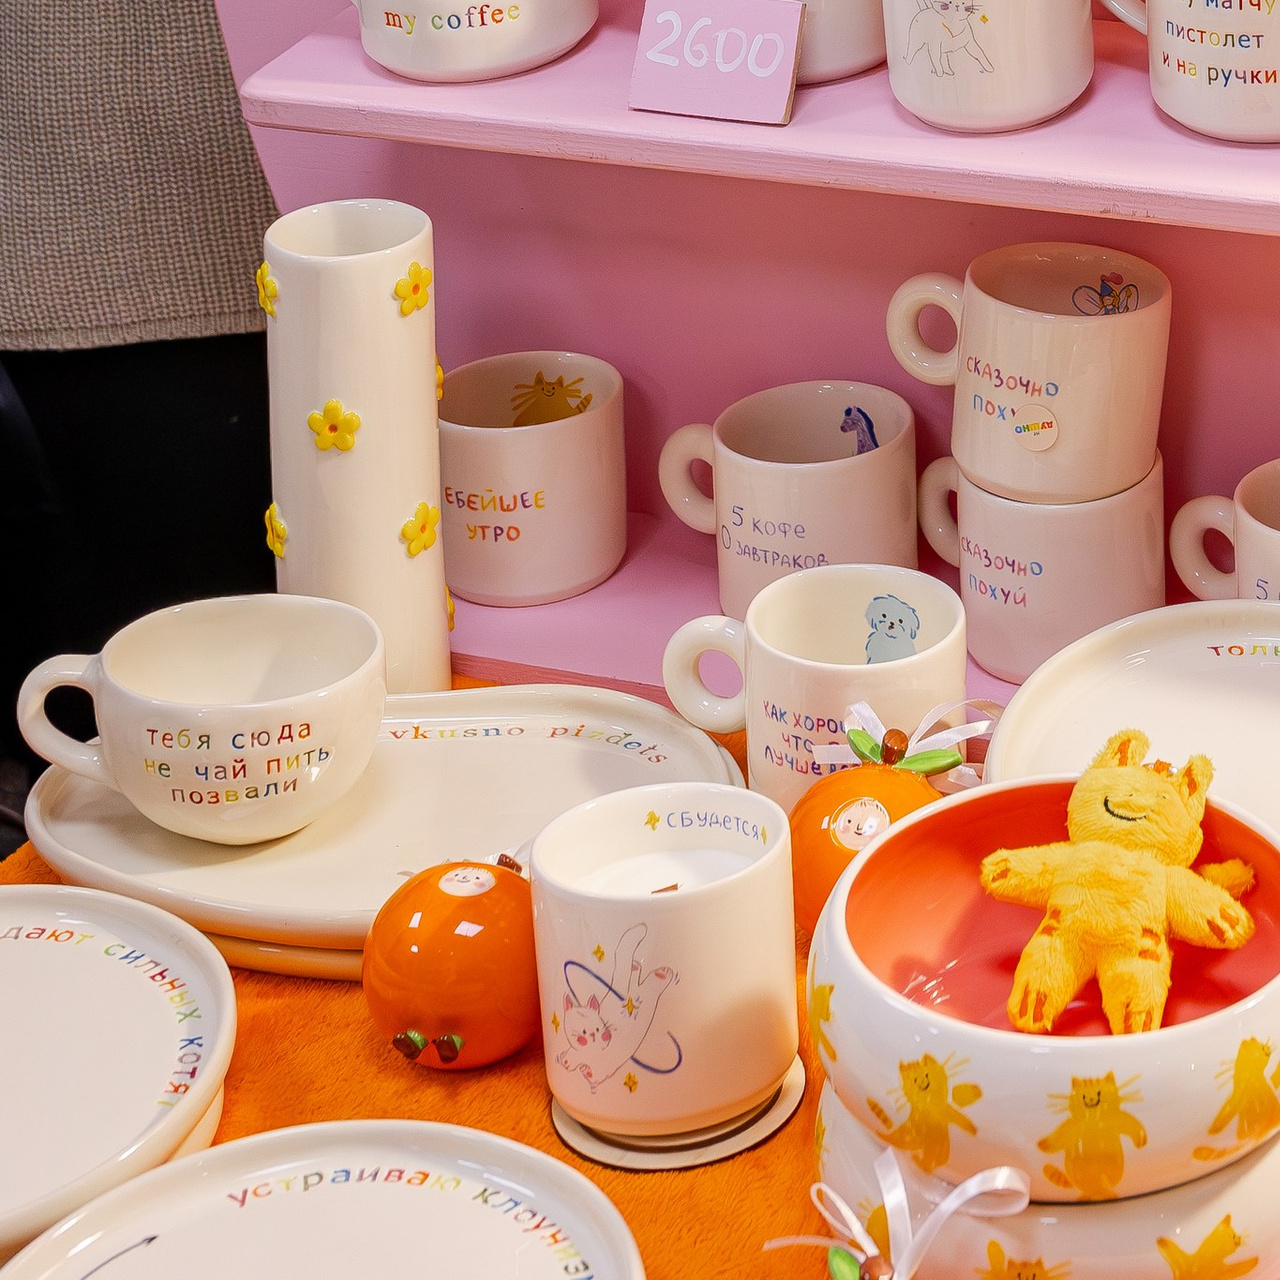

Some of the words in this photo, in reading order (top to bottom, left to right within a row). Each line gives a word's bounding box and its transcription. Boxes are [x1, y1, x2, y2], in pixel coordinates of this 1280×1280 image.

[384, 11, 416, 35] my
[431, 4, 520, 30] coffee
[1165, 19, 1264, 50] пистолет
[645, 9, 785, 79] 2600
[1162, 51, 1170, 69] и
[1176, 57, 1197, 77] на
[1207, 65, 1278, 89] ручки
[967, 356, 1059, 398] СКАЗОЧНО
[467, 523, 520, 542] УТРО
[732, 505, 744, 527] 5
[961, 536, 1043, 577] СКАЗОЧНО
[968, 573, 1027, 608] ПОХУЙ
[1256, 578, 1269, 601] 5
[763, 700, 788, 725] КАК
[146, 728, 211, 750] тебя
[231, 722, 311, 749] сюда
[389, 724, 525, 740] vkusno
[549, 723, 668, 765] pizdets
[144, 757, 171, 778] не
[195, 758, 247, 781] чай
[266, 747, 329, 775] пить
[171, 778, 298, 805] позвали
[103, 943, 202, 1024] сильных
[227, 1166, 461, 1209] устраиваю
[472, 1186, 595, 1280] клоуниз
